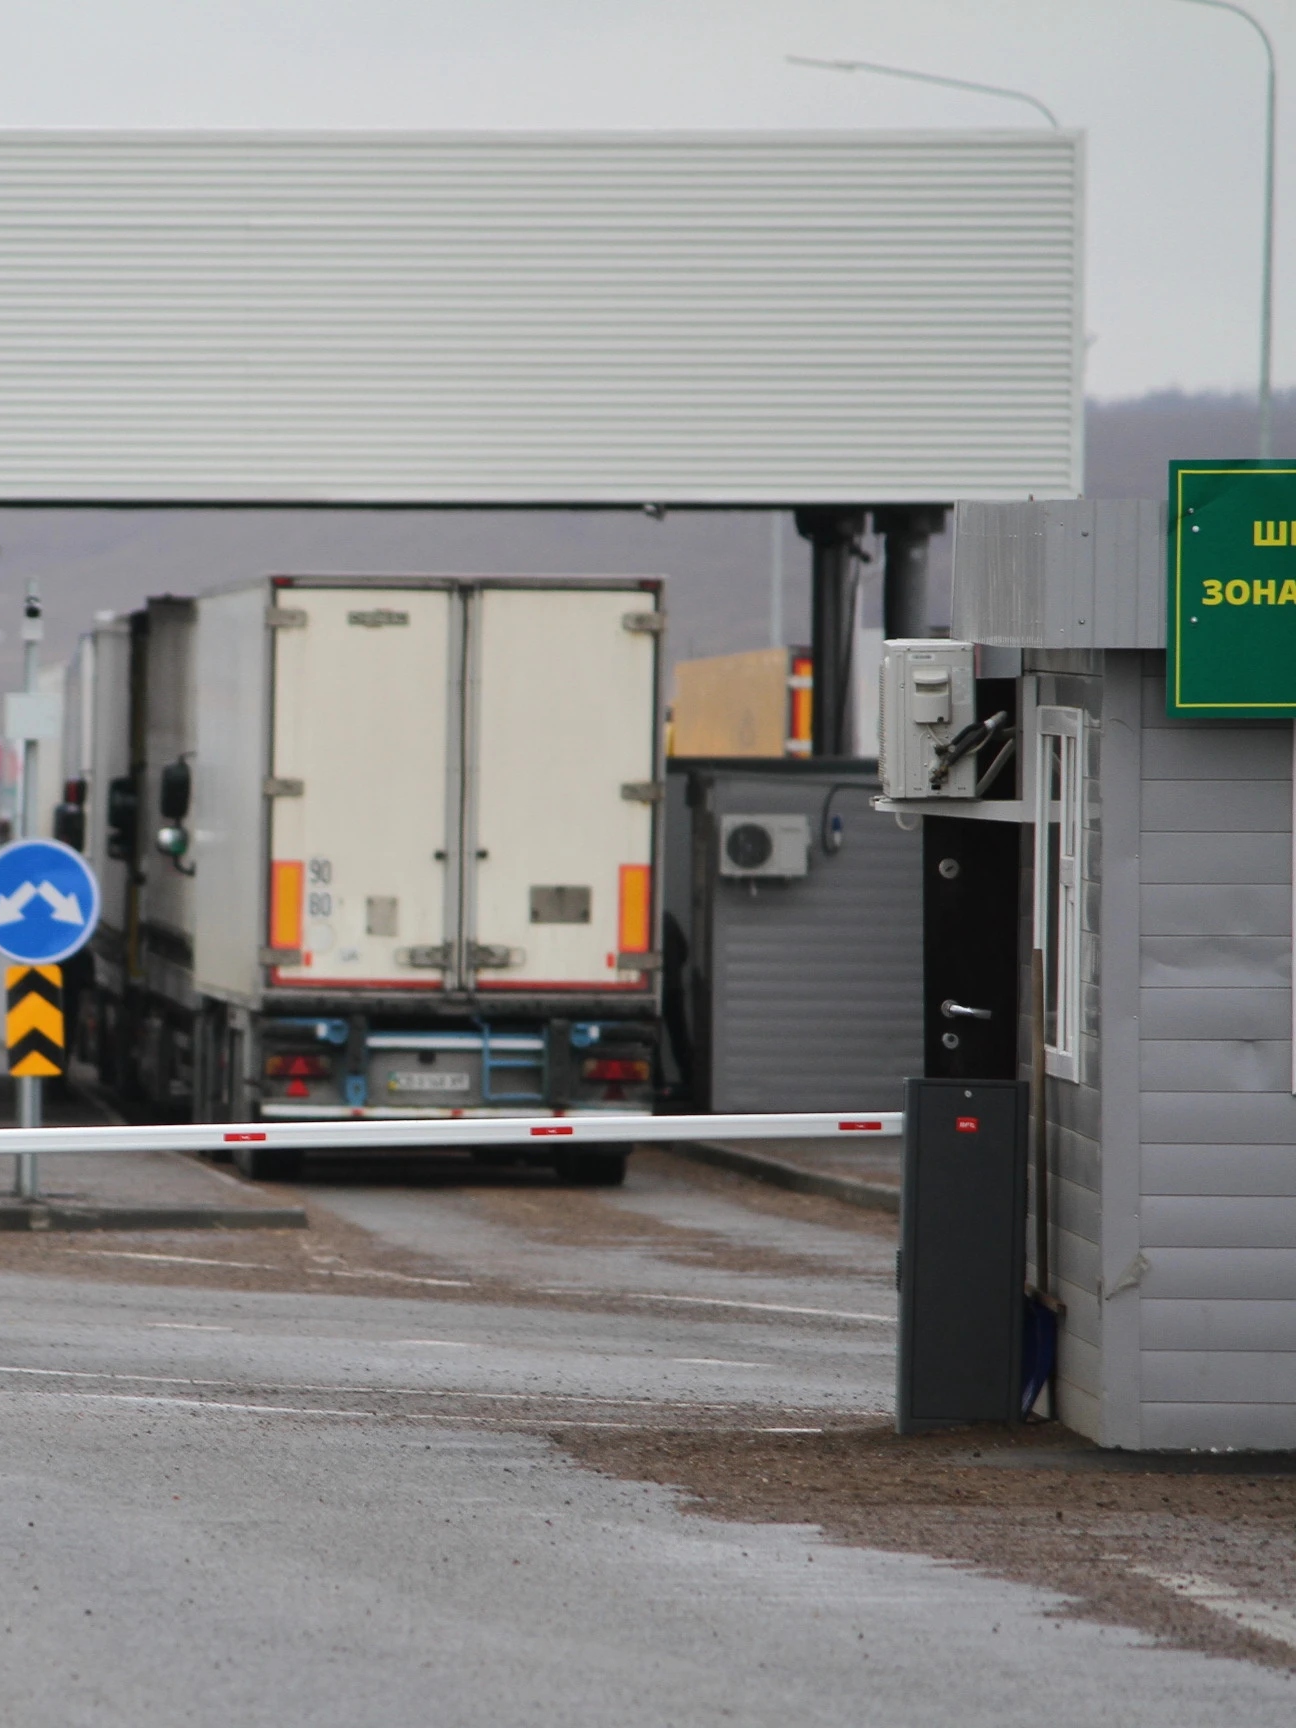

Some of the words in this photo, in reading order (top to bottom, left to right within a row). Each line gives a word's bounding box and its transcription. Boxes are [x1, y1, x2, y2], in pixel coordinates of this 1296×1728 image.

[1253, 520, 1296, 546] Ш
[1202, 579, 1296, 606] ЗОНА
[309, 859, 332, 884] 90
